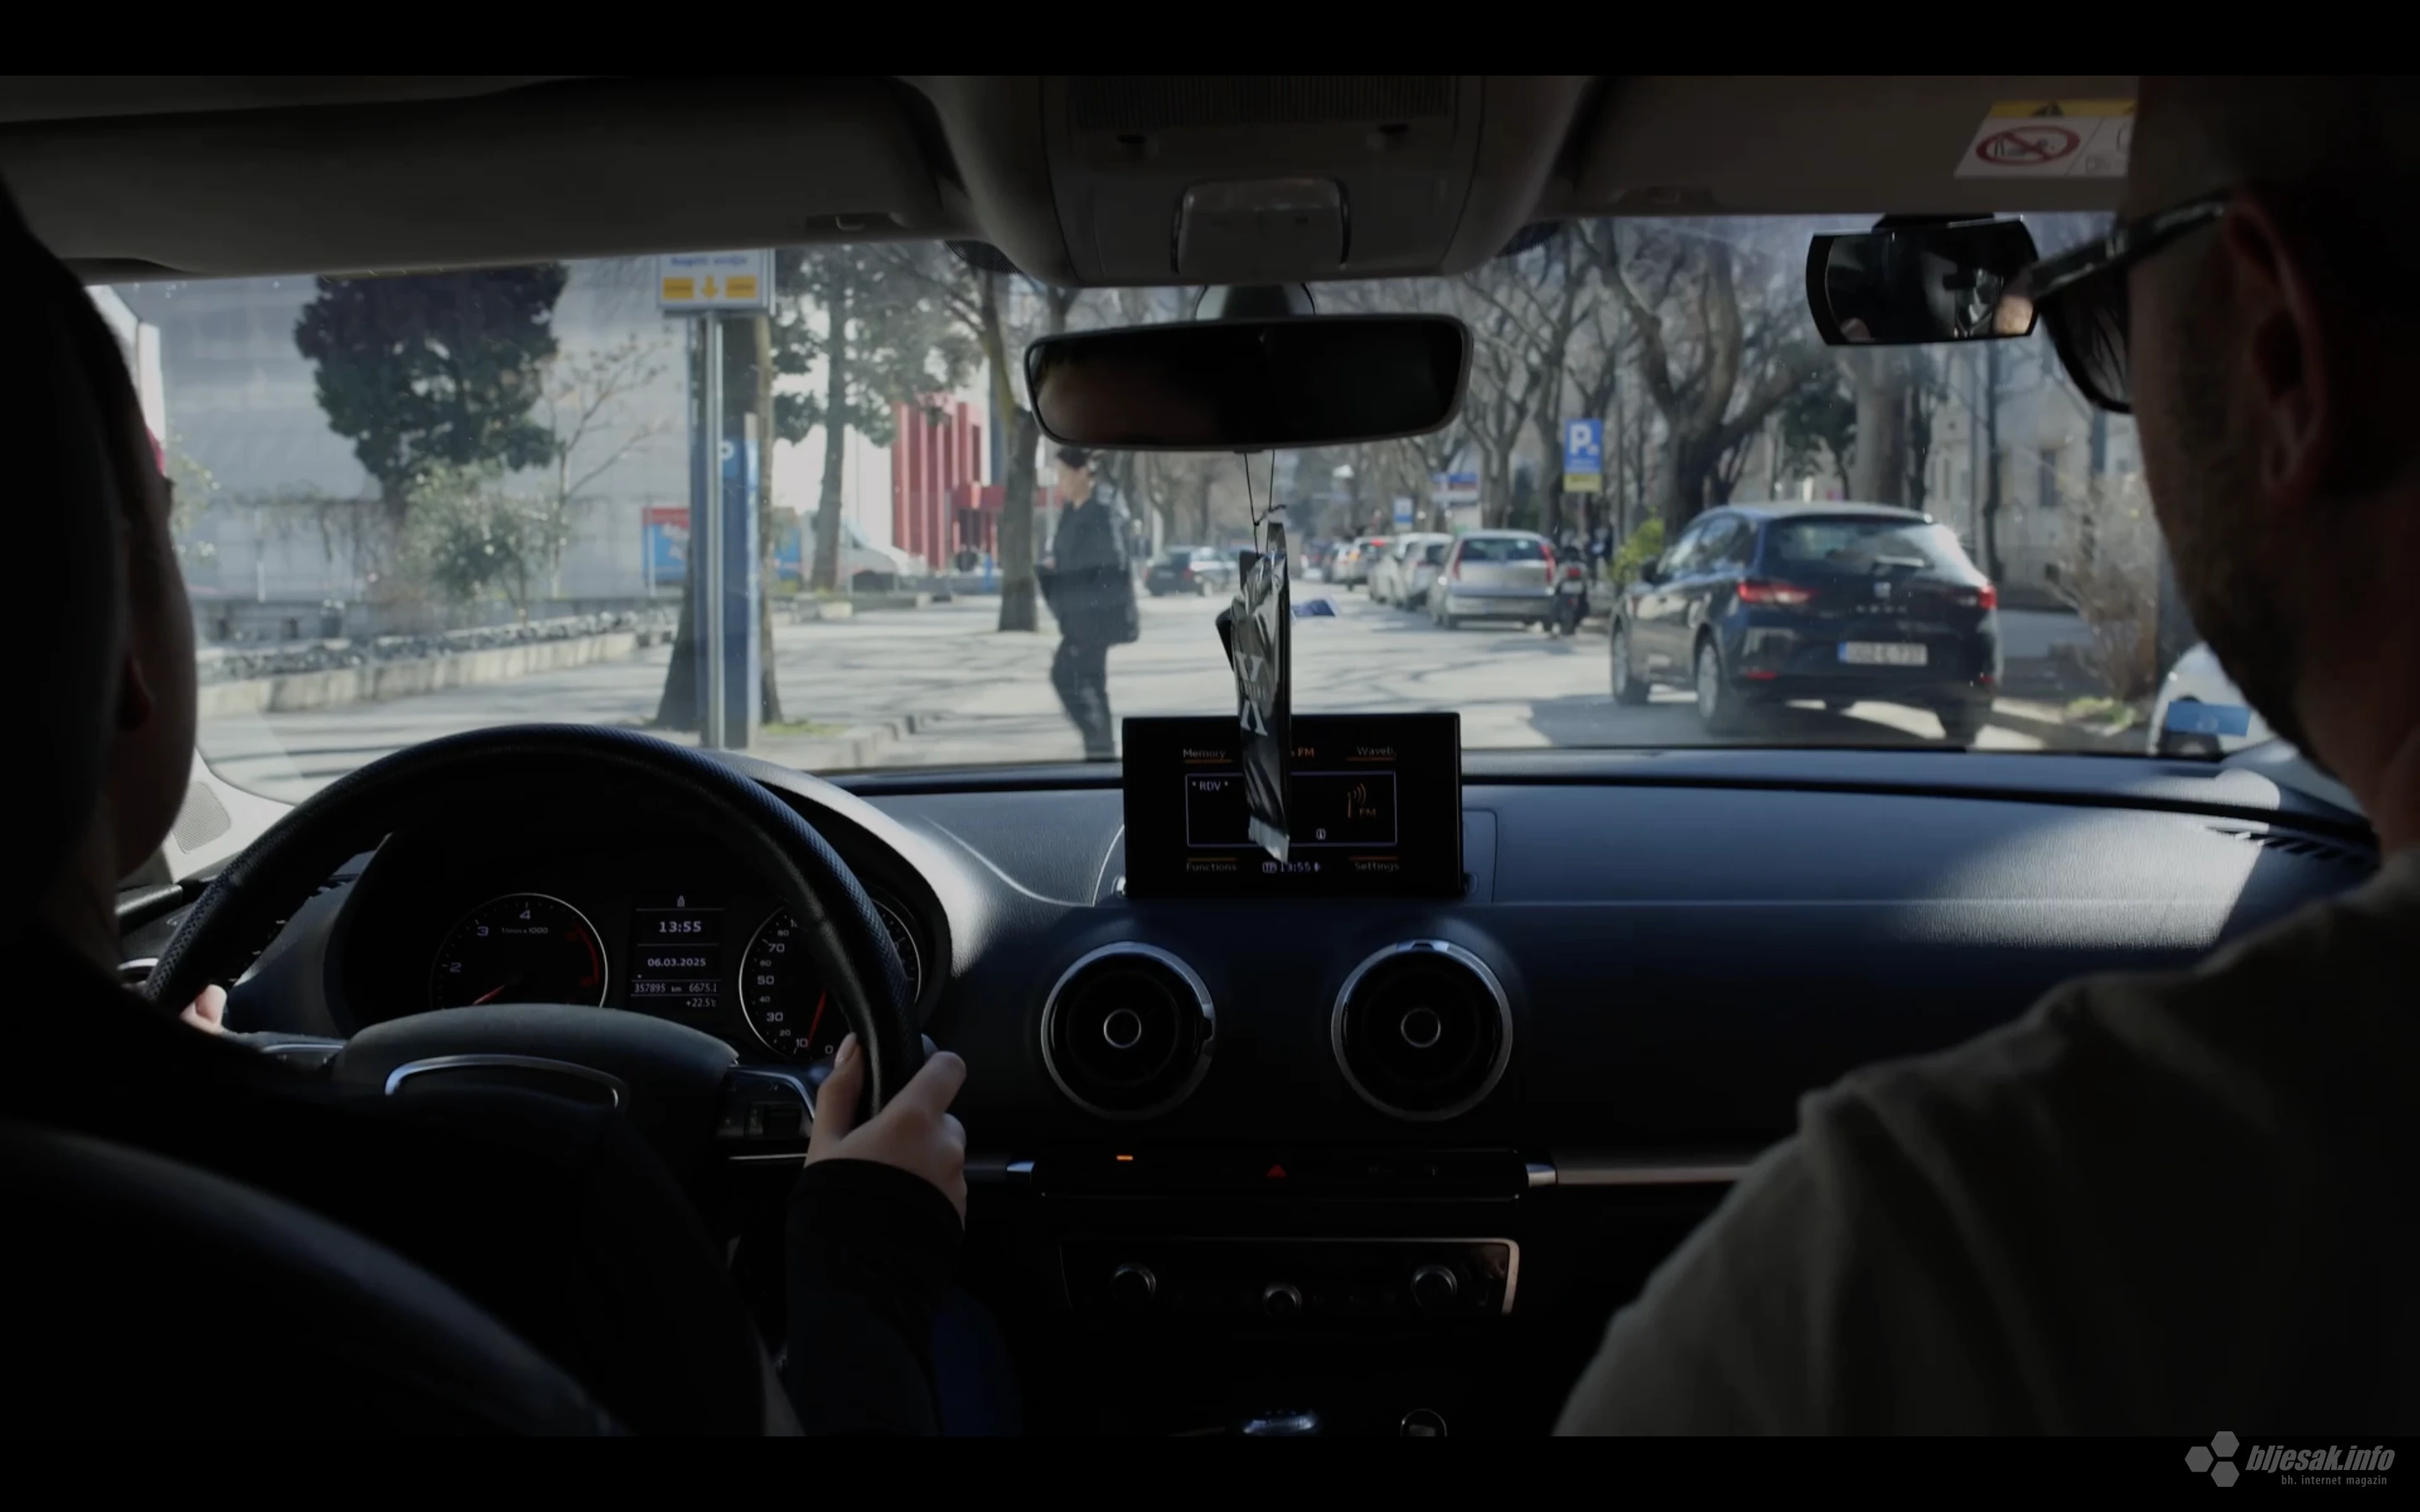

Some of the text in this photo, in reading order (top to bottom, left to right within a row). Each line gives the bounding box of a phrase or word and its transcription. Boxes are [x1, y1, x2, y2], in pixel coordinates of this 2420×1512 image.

[1570, 423, 1591, 455] P
[1182, 748, 1226, 759] Memory
[1297, 746, 1315, 757] FM
[1199, 780, 1222, 791] RDV
[1359, 807, 1376, 817] FM
[1186, 862, 1238, 872] Functions
[1281, 862, 1311, 874] 13:55
[1354, 862, 1400, 873] Settings
[518, 909, 532, 920] 4
[476, 926, 490, 937] 3
[659, 921, 702, 933] 13:55
[767, 943, 786, 953] 70
[449, 962, 462, 973] 2
[647, 958, 707, 967] 06.03.2025
[756, 974, 775, 985] 50
[634, 983, 666, 993] 357895
[688, 983, 717, 993] 6675.1
[765, 1011, 784, 1022] 30
[796, 1038, 808, 1048] 10
[824, 1045, 834, 1054] 0
